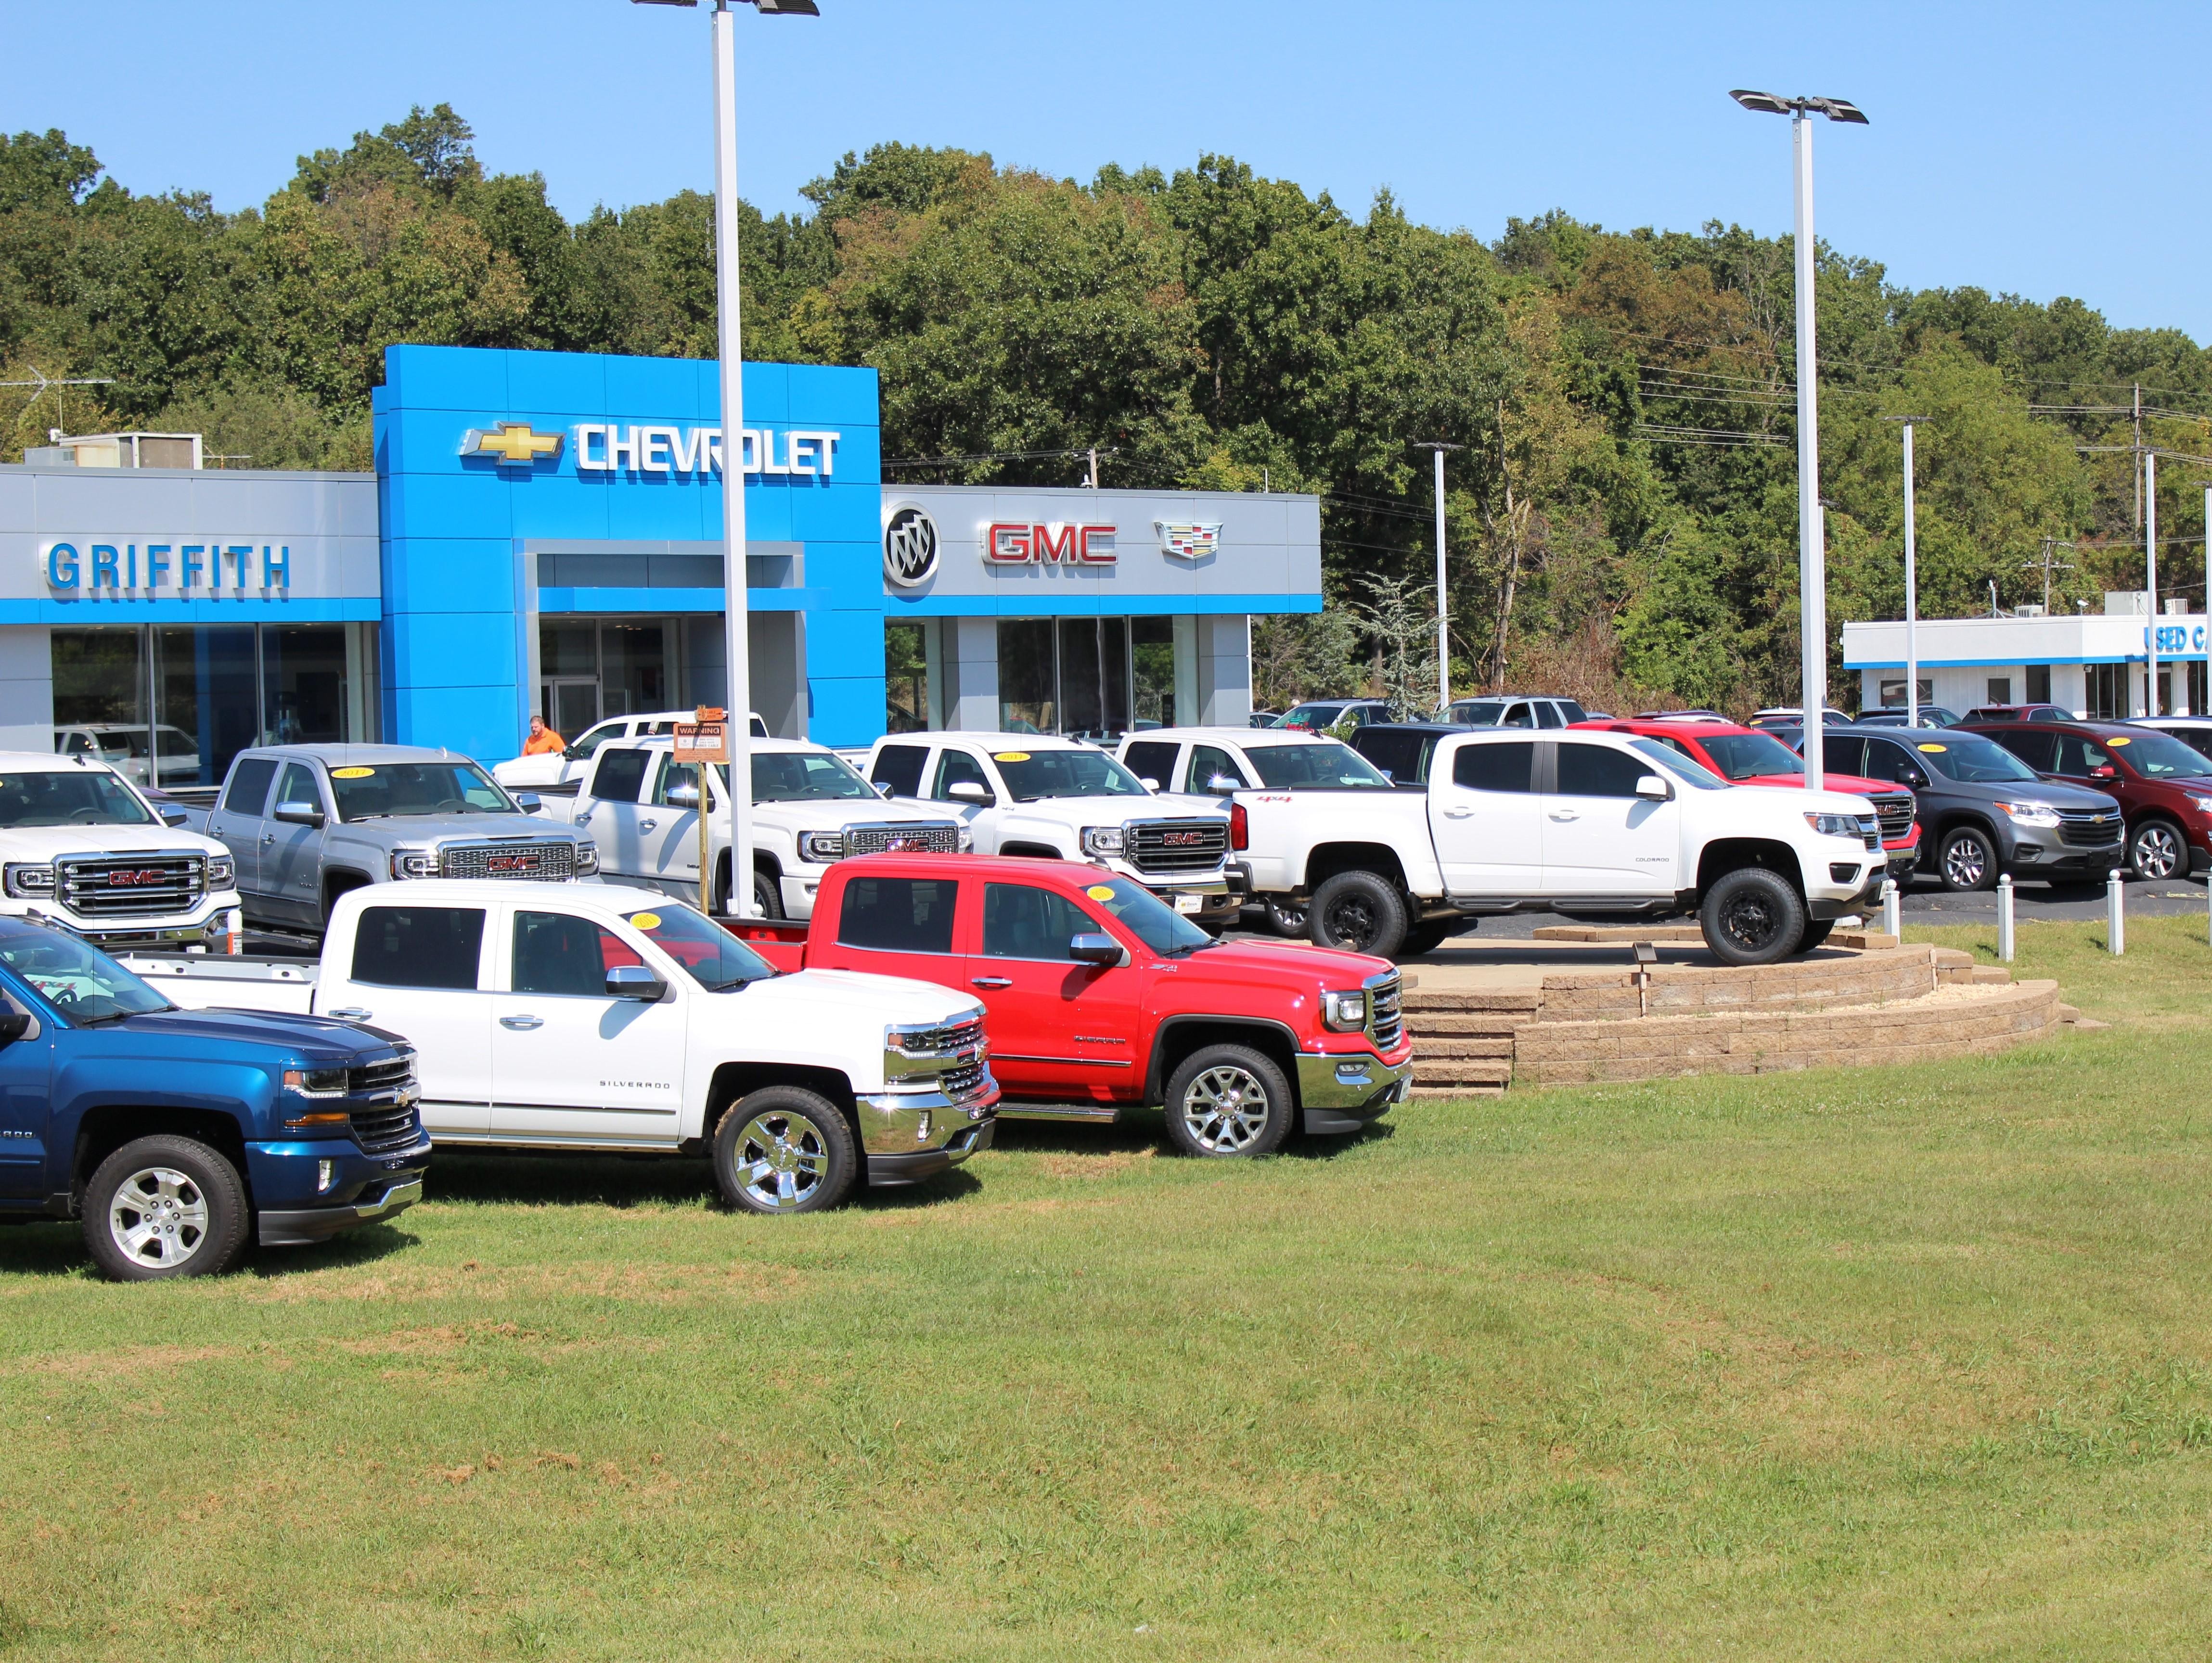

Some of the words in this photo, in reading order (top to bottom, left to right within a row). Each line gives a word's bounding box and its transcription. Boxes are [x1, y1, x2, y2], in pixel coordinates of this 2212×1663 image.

[575, 424, 840, 475] CHEVROLET
[982, 521, 1118, 565] GMC
[45, 543, 289, 590] GRIFFITH
[1876, 805, 1898, 815] MC
[887, 839, 928, 851] GMC
[1164, 832, 1202, 845] GMC
[489, 856, 538, 870] GMC
[110, 869, 165, 885] GMC
[636, 915, 656, 928] 2017
[1074, 1036, 1125, 1044] SIERRA
[600, 1081, 670, 1089] SILVERADO
